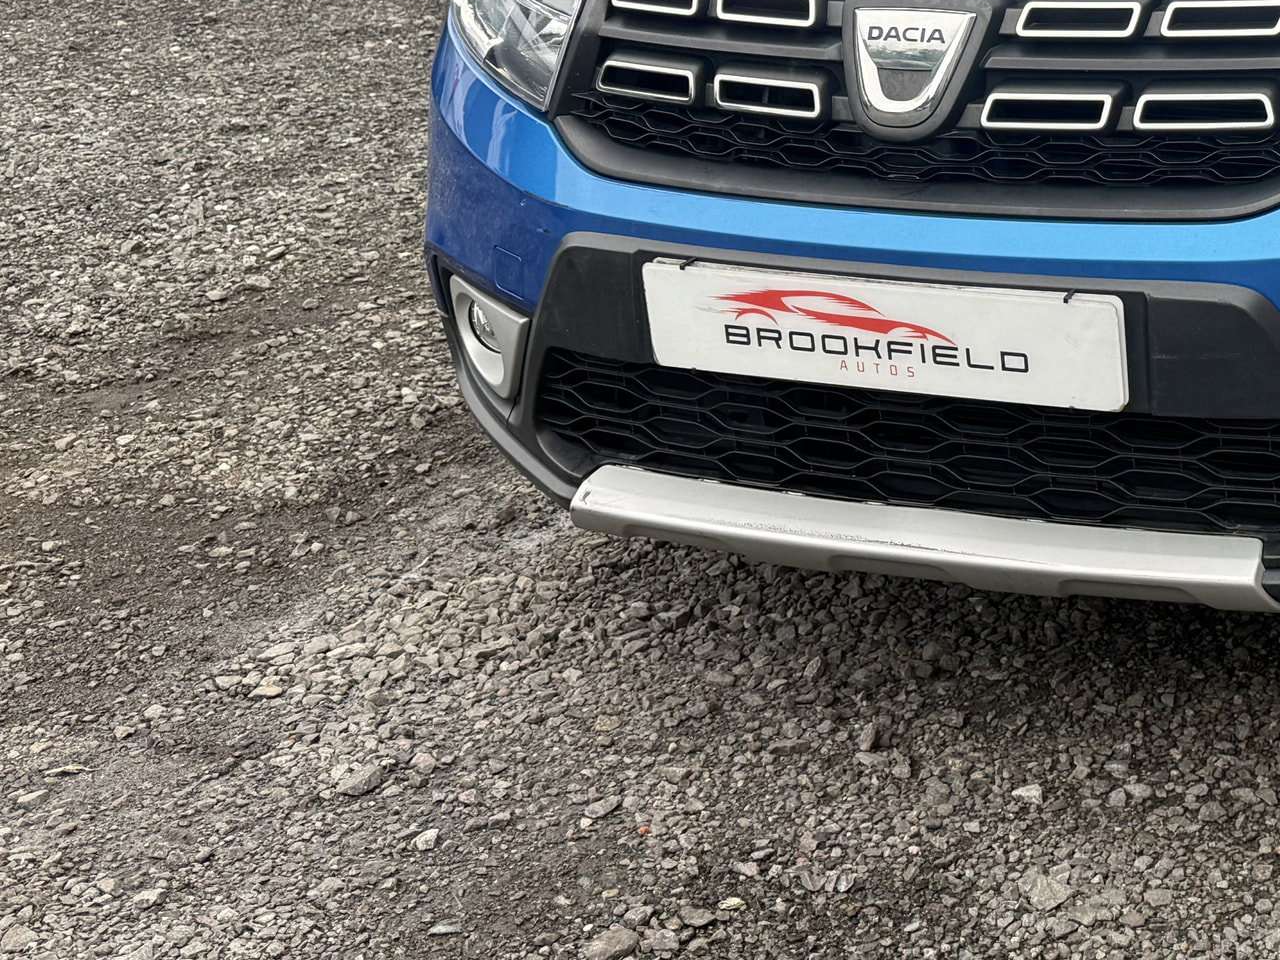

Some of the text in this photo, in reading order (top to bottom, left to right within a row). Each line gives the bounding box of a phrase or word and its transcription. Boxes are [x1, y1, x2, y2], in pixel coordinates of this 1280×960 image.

[867, 25, 946, 45] DACIA
[724, 323, 1030, 374] BROOKFIELD
[839, 359, 917, 378] AUTOS
